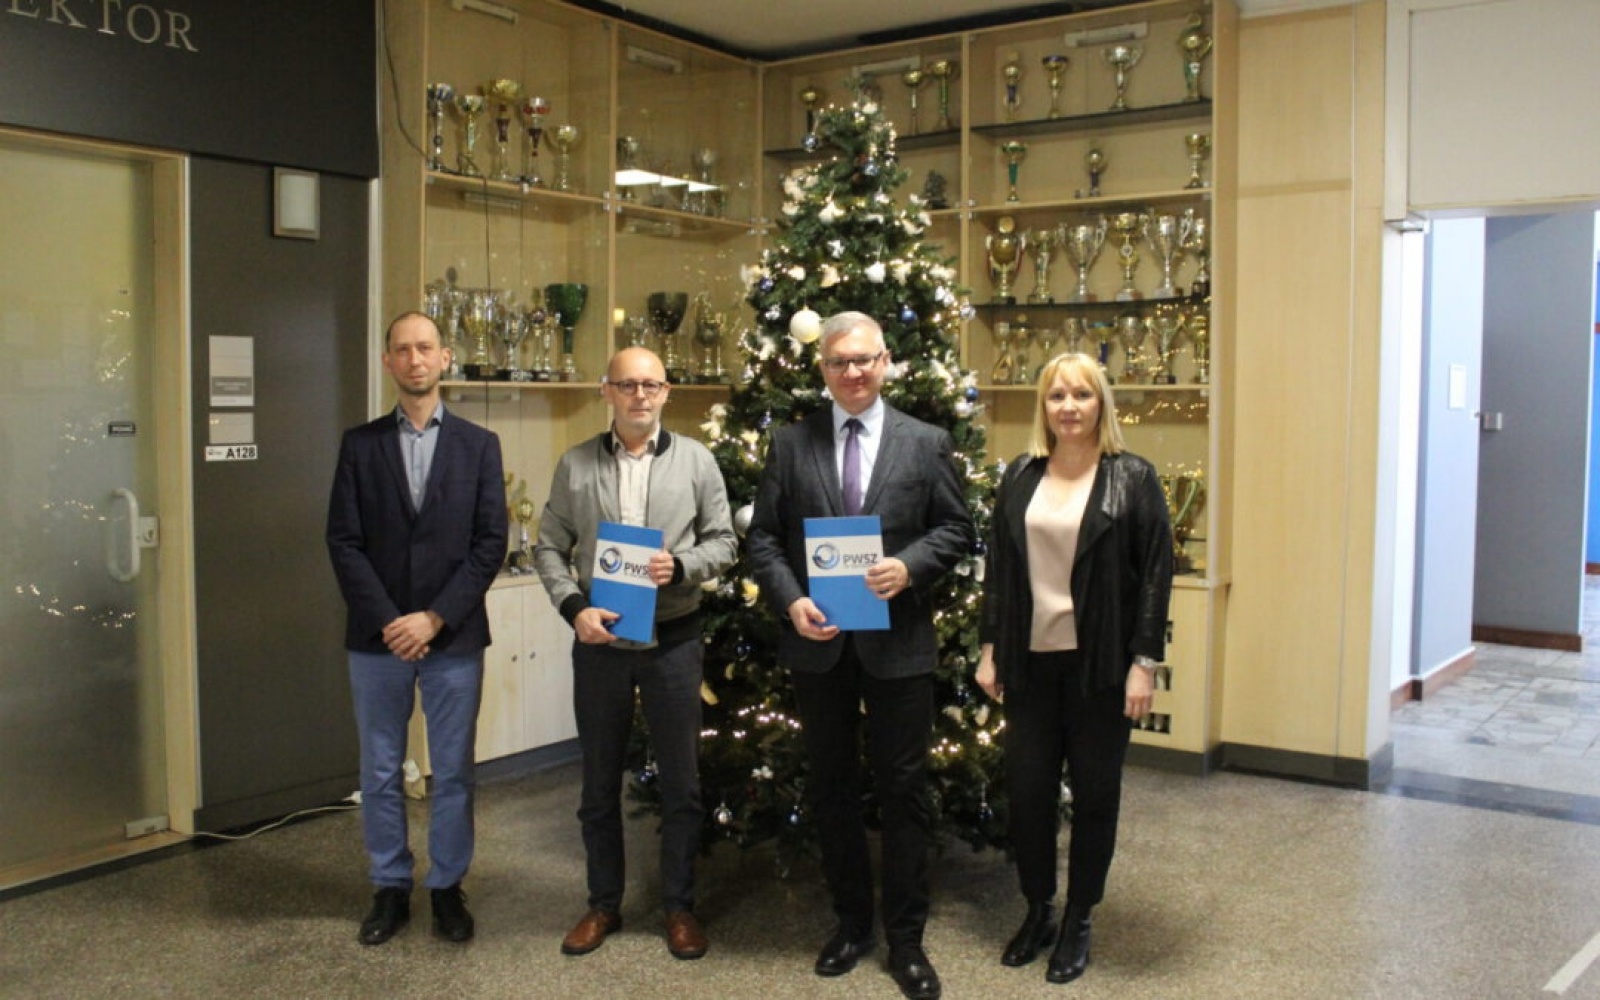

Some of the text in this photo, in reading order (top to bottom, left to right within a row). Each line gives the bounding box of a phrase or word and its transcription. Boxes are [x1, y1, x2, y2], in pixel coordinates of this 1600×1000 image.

[226, 447, 256, 459] A128
[843, 553, 878, 564] PWSZ
[624, 562, 650, 575] PWS
